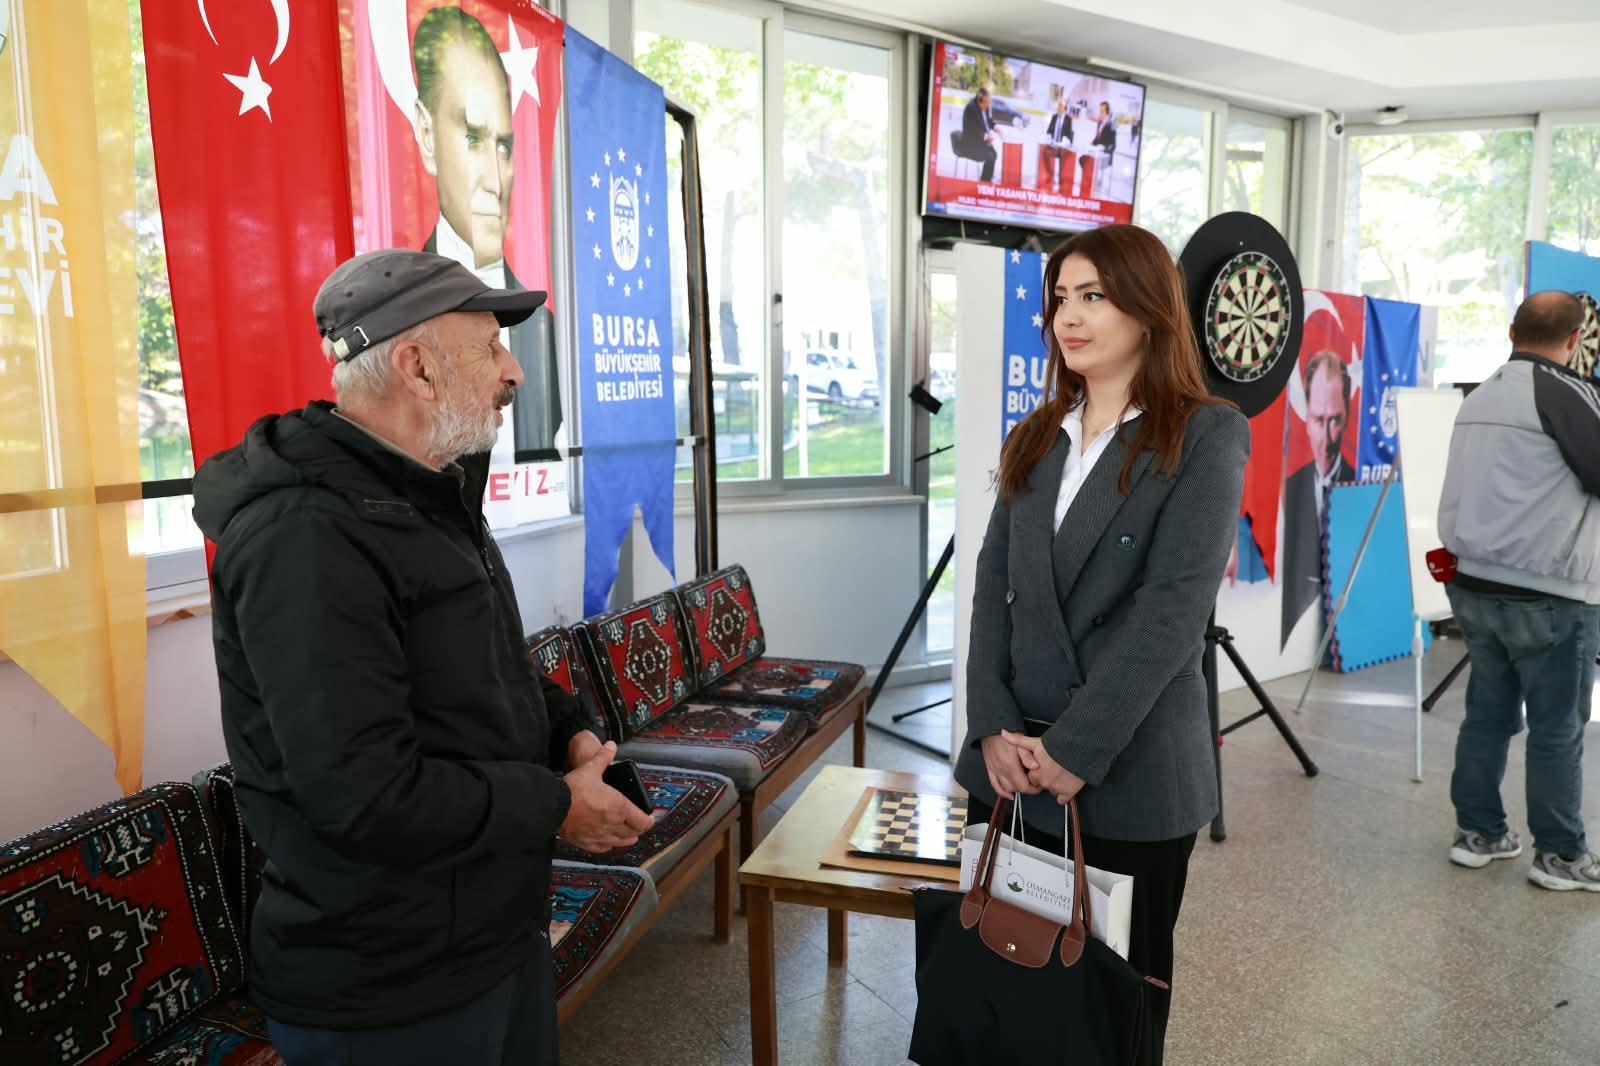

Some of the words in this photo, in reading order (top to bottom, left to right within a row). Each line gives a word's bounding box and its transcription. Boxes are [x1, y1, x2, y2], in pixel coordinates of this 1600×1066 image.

[592, 312, 660, 347] BURSA
[594, 348, 661, 377] BÜYÜKŞEHİR
[596, 374, 663, 402] BELEDİYESİ
